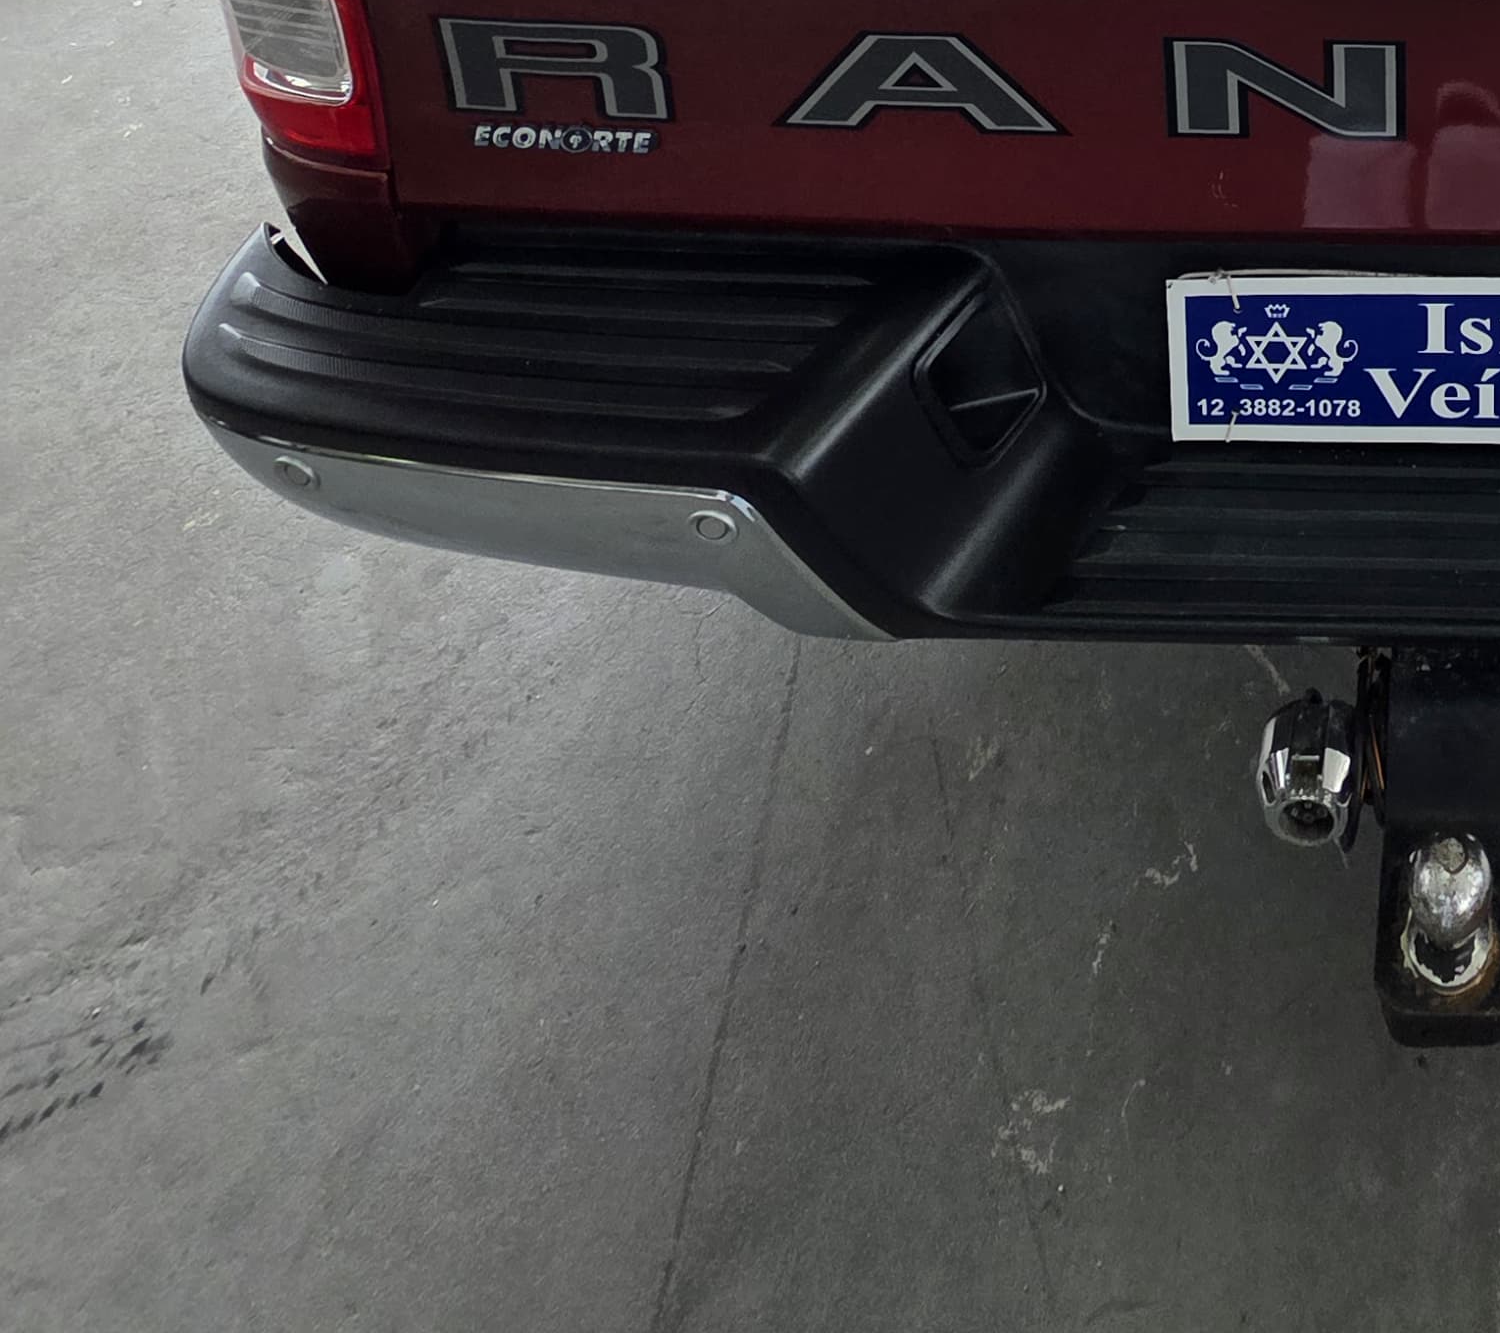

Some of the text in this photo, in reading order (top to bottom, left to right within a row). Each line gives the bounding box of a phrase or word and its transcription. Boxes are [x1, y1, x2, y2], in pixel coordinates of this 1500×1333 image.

[474, 124, 652, 155] ECONORTE
[1197, 398, 1361, 418] 12 3882-1078
